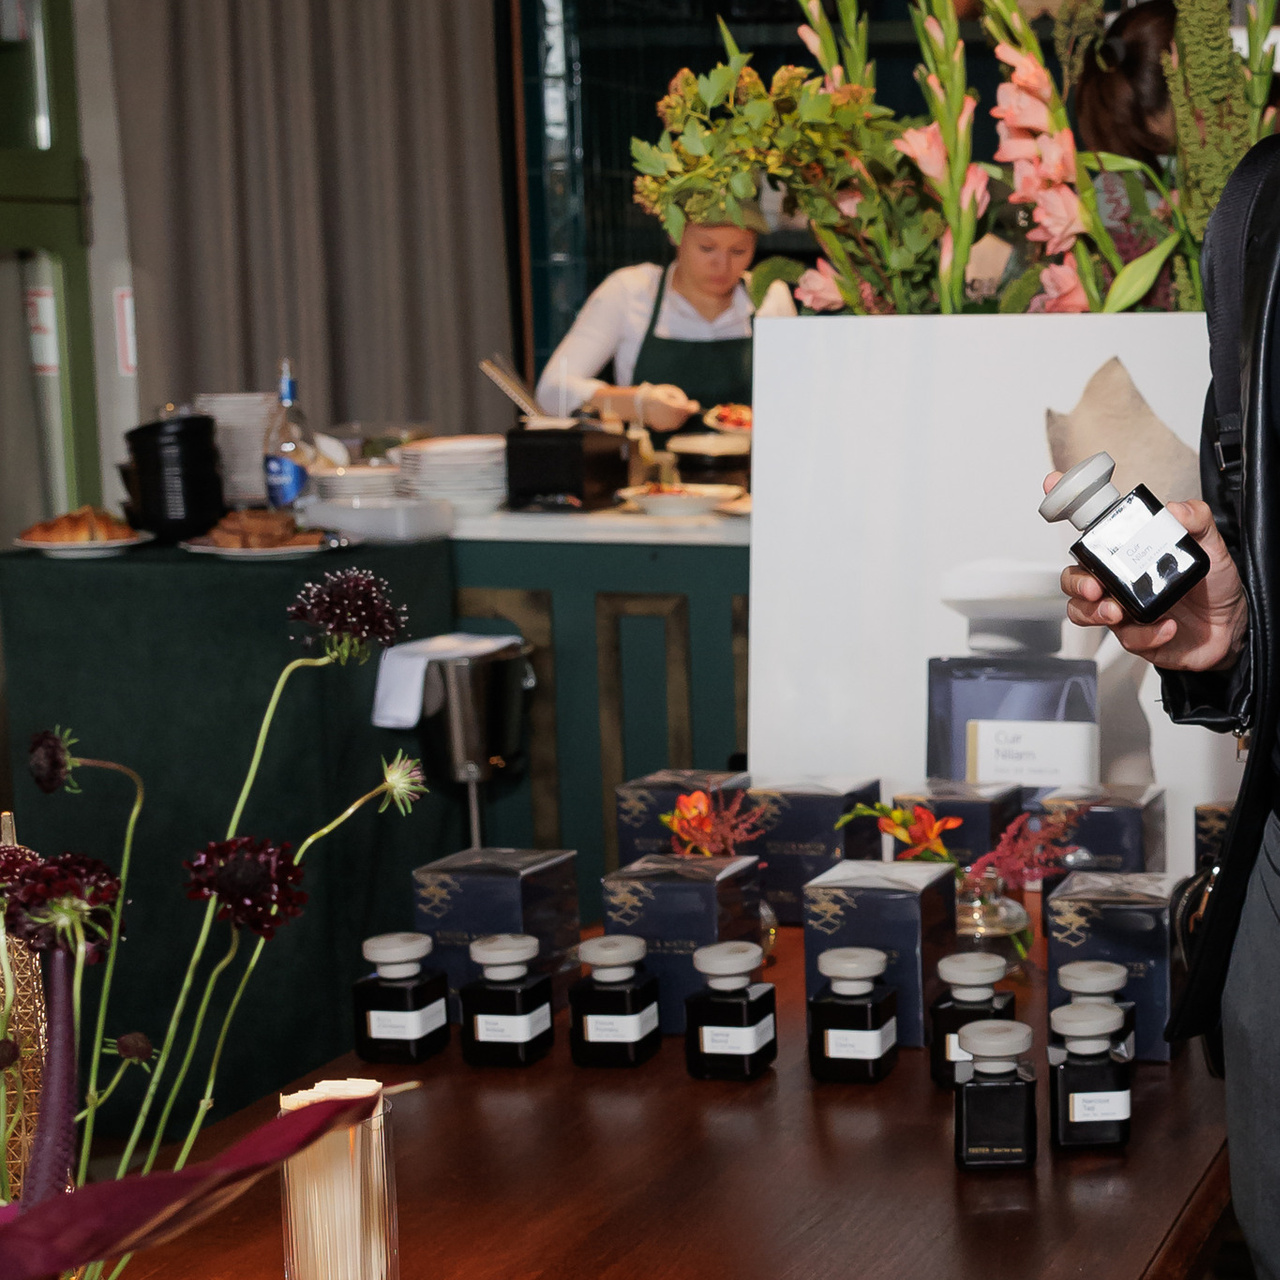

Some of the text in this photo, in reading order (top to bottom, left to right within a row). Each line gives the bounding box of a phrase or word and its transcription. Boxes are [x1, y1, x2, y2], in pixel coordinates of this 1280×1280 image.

[1126, 542, 1141, 557] Cuir
[1132, 544, 1153, 564] Nilam
[994, 730, 1022, 744] Cuir
